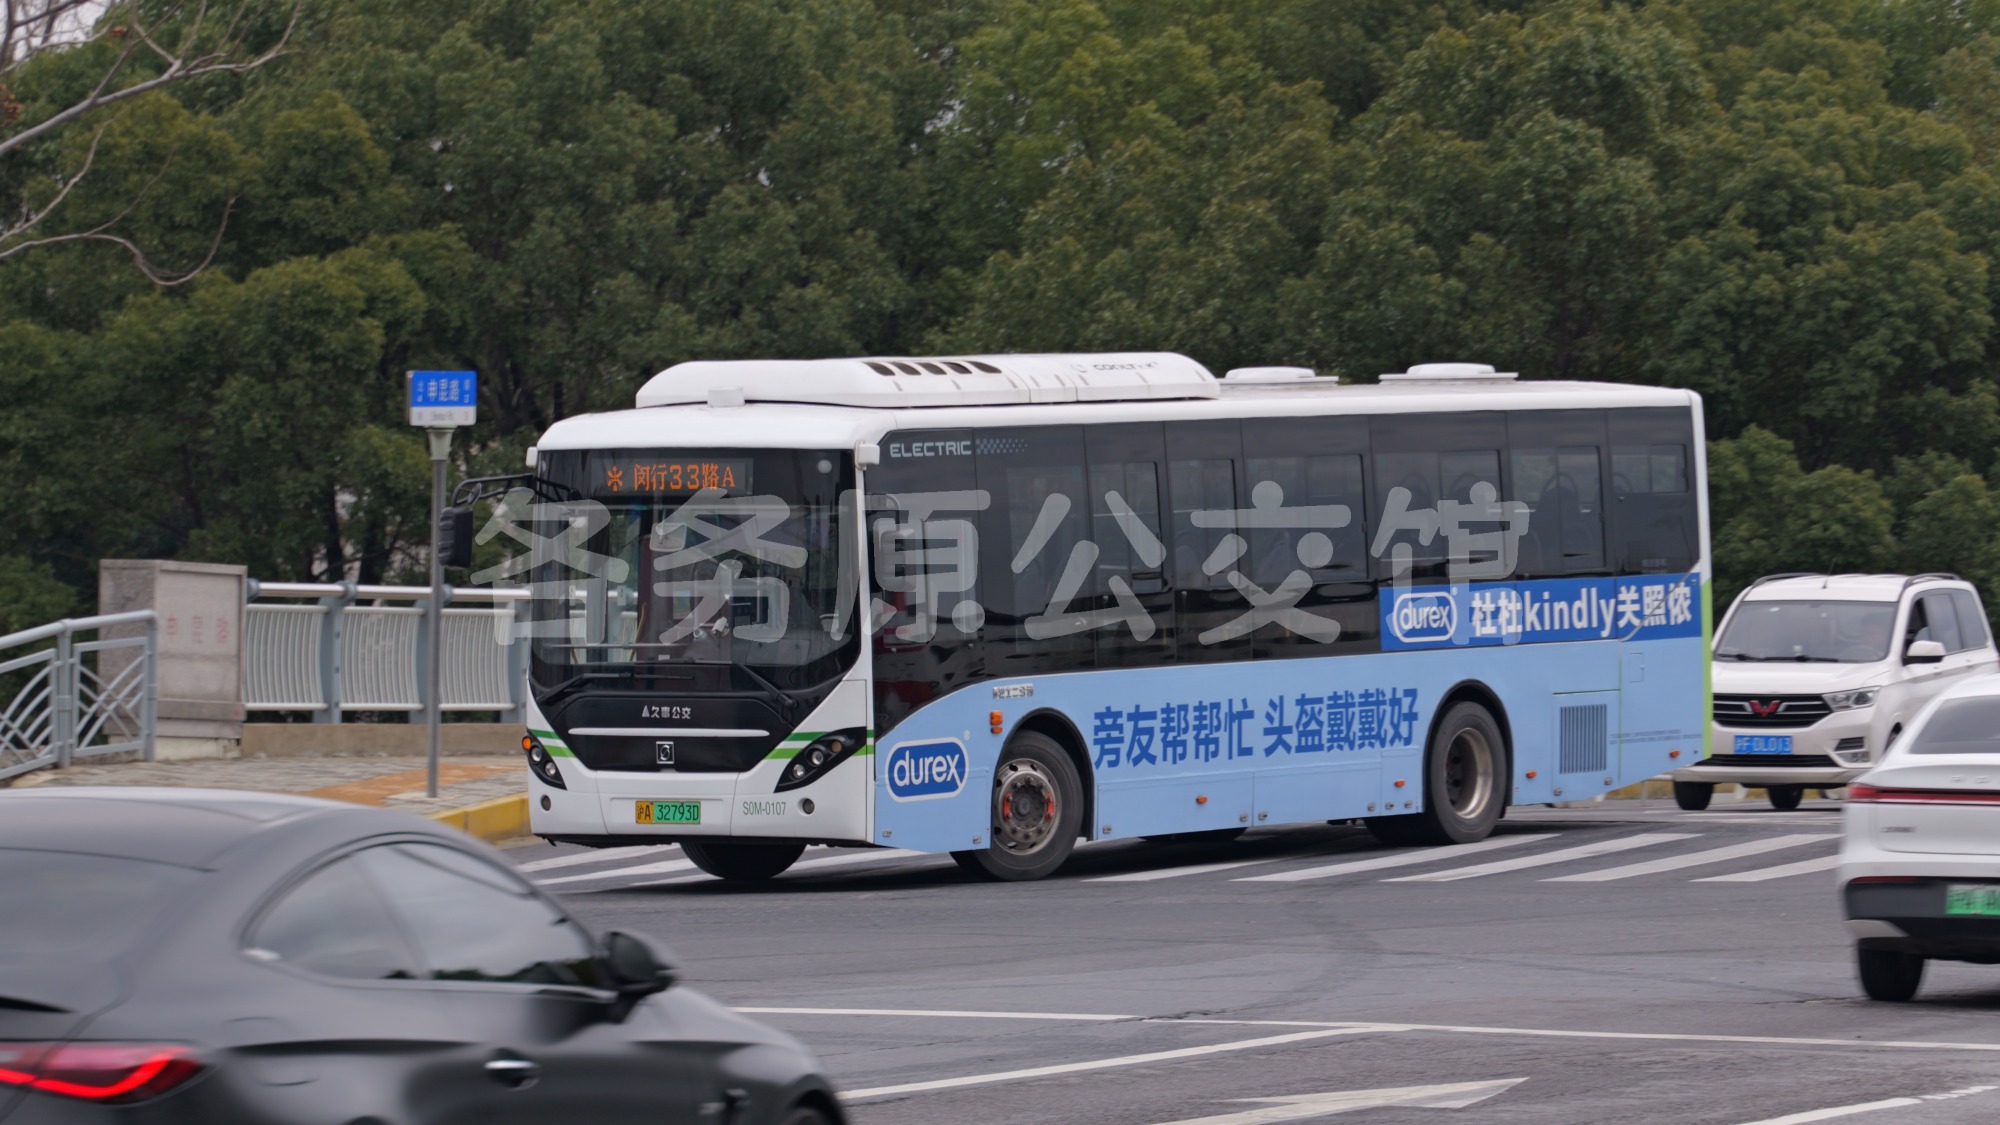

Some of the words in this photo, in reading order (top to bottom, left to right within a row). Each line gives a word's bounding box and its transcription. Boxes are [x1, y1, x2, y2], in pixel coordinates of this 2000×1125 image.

[890, 440, 972, 458] ELECTRIC
[633, 463, 736, 491] 闵行33路A
[1400, 603, 1450, 630] durex
[650, 705, 692, 719] 久事公交
[1093, 697, 1255, 770] 旁友帮帮忙
[1263, 687, 1419, 758] 头盔戴戴好
[893, 750, 962, 787] durex
